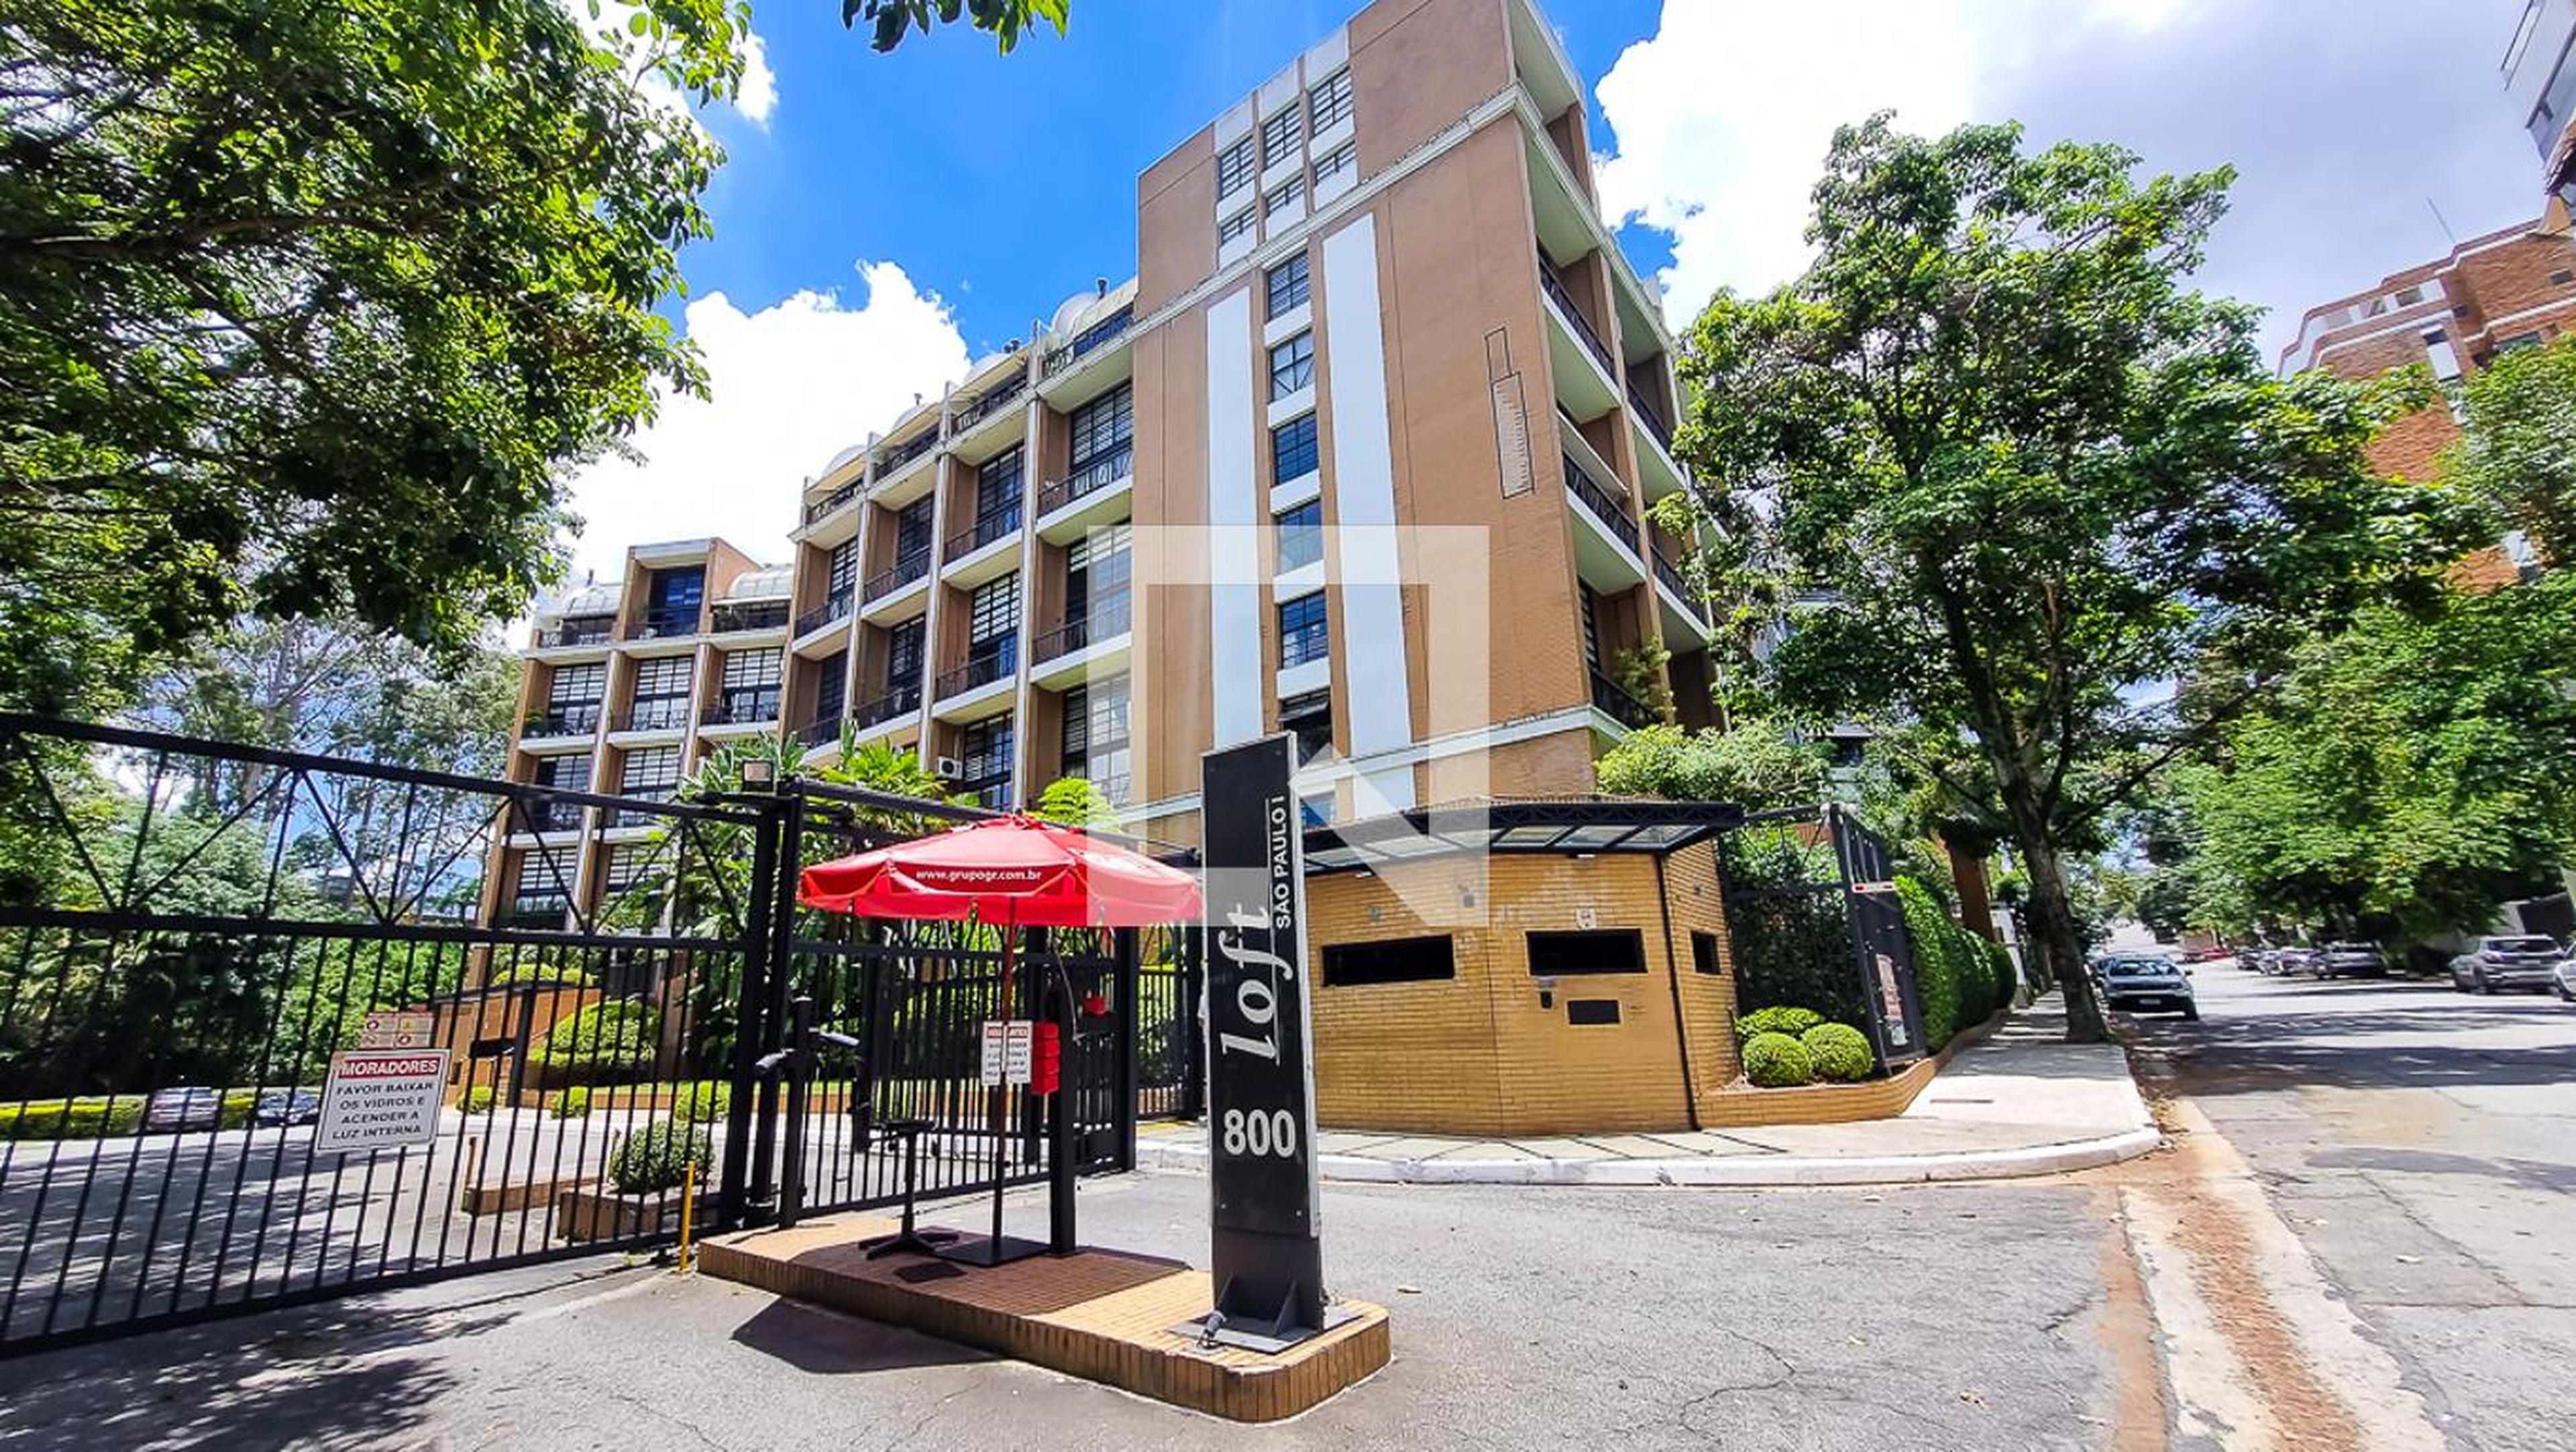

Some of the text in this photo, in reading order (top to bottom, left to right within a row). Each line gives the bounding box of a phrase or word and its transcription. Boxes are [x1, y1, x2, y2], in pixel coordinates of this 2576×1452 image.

[1271, 807, 1288, 878] PAULO
[916, 870, 1041, 882] www.grupogr.com.br
[1218, 903, 1293, 1059] loft
[340, 1060, 438, 1075] MORADORES
[337, 1082, 433, 1095] FAVOR BAIXAR
[339, 1096, 425, 1110] OS VIDROS E
[341, 1111, 419, 1124] ACENDER A
[332, 1125, 421, 1139] LUZ INTERNA
[1224, 1109, 1296, 1157] 800
